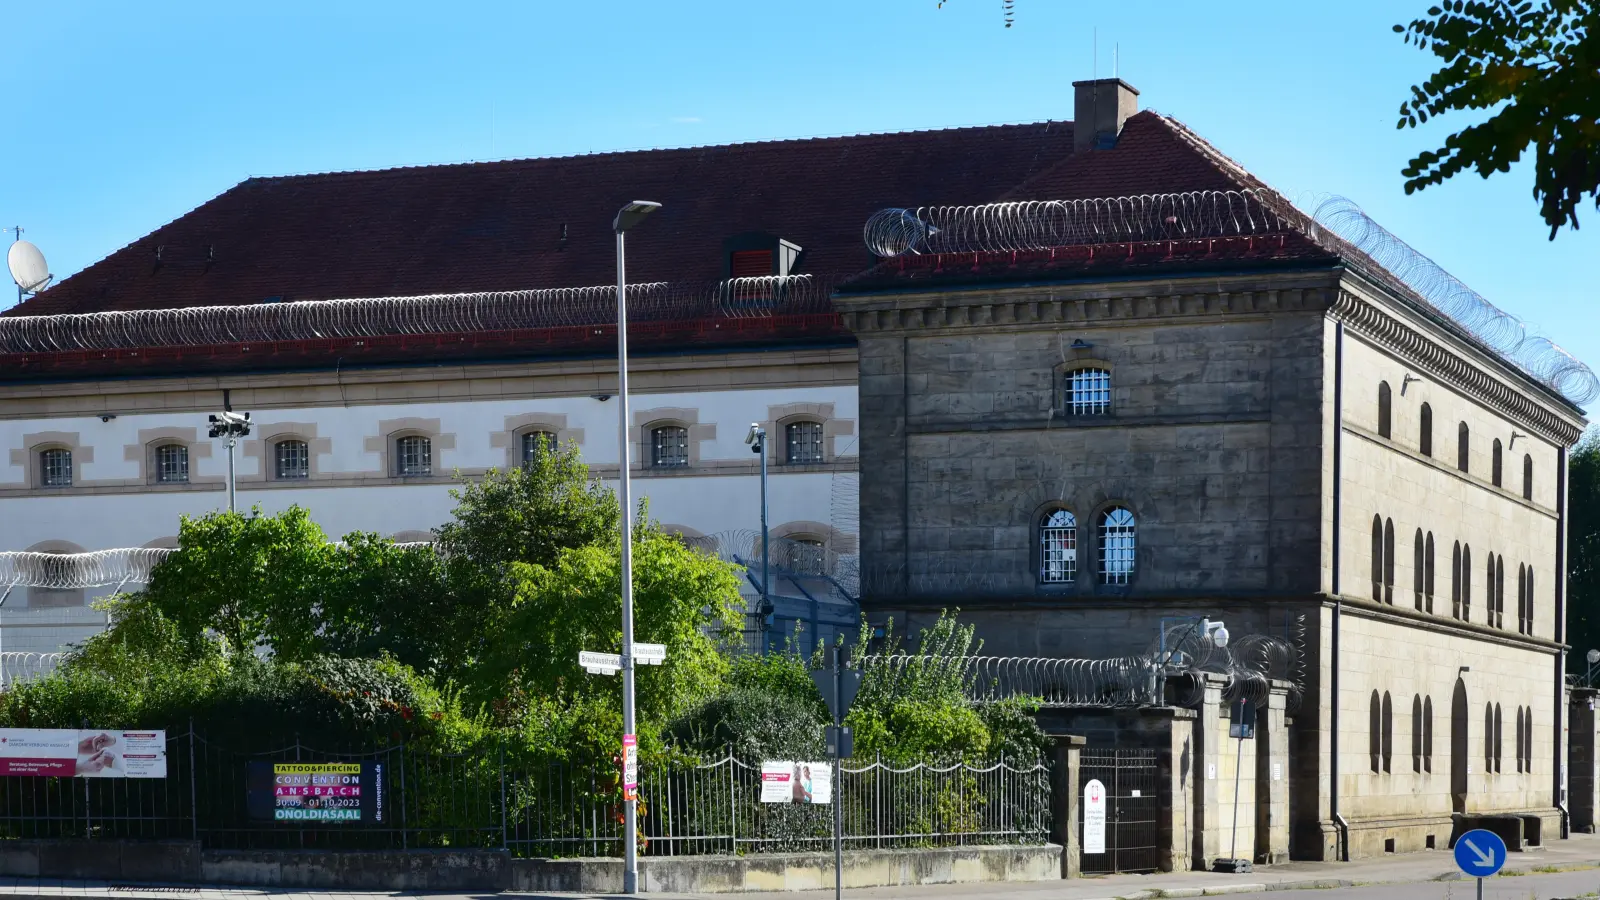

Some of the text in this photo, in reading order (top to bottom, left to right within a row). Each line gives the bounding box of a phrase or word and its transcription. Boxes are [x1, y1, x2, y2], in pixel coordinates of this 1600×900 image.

[581, 654, 619, 666] Brauhausstraße
[275, 776, 359, 784] CONVENTION
[308, 799, 360, 807] 01.10.2023
[275, 809, 360, 819] ONOLDIASAAL
